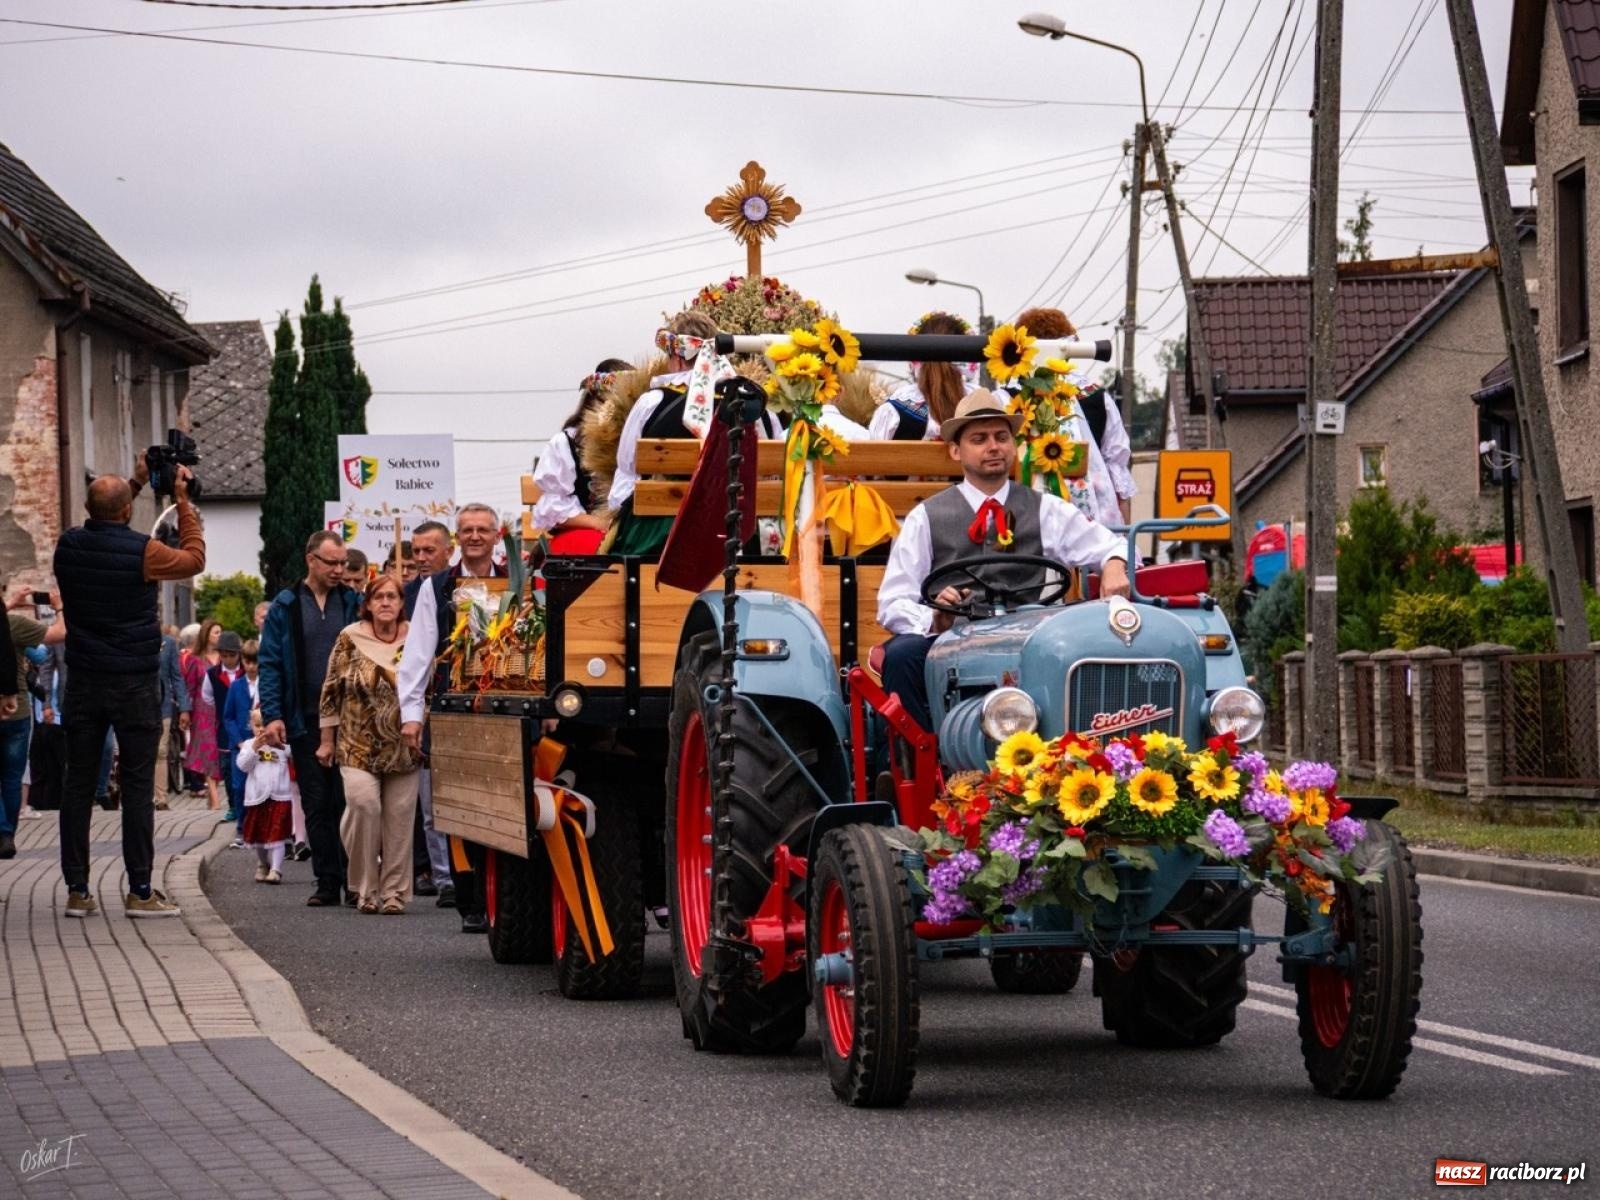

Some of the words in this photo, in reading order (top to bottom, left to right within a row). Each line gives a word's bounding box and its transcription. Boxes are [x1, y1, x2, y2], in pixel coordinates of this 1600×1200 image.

[395, 478, 434, 490] Babice
[1176, 481, 1212, 495] STRAŻ
[1091, 703, 1157, 732] Eicher
